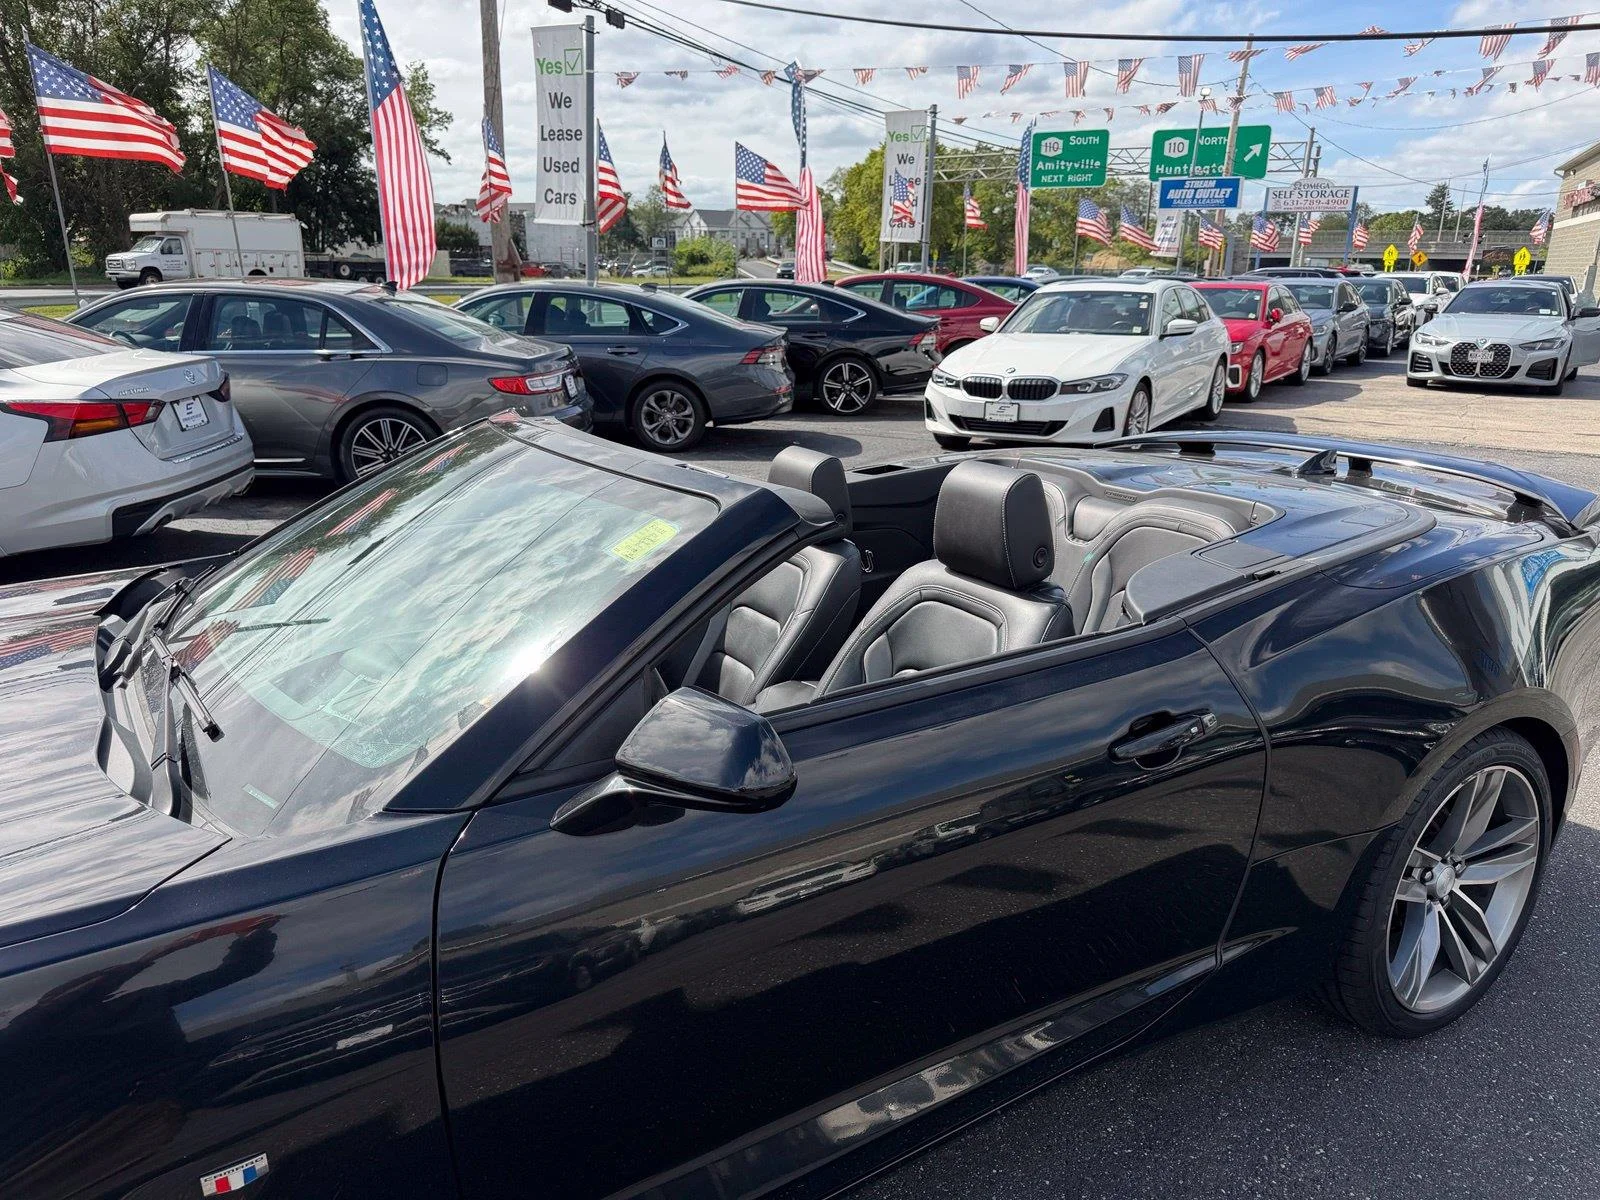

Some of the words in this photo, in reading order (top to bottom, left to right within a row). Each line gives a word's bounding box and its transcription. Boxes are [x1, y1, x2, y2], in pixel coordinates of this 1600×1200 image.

[536, 57, 563, 75] Yes
[548, 92, 572, 109] We
[540, 125, 583, 142] Lease
[888, 131, 909, 142] Yes
[1044, 141, 1059, 153] 110
[1069, 135, 1100, 145] SOUTH
[1168, 142, 1185, 153] 110
[543, 157, 580, 173] Used
[896, 153, 915, 165] We
[1036, 159, 1101, 172] Amityville
[1041, 174, 1064, 183] NEXT
[1067, 173, 1093, 182] RIGHT
[1184, 179, 1217, 188] STREAM
[1302, 182, 1330, 190] OMEGA
[544, 188, 577, 205] Cars
[1166, 188, 1195, 199] AUTO
[1195, 187, 1233, 199] OUTLET
[1272, 190, 1295, 199] SELF
[1297, 189, 1350, 199] STORAGE
[204, 1156, 264, 1182] CAMARO
